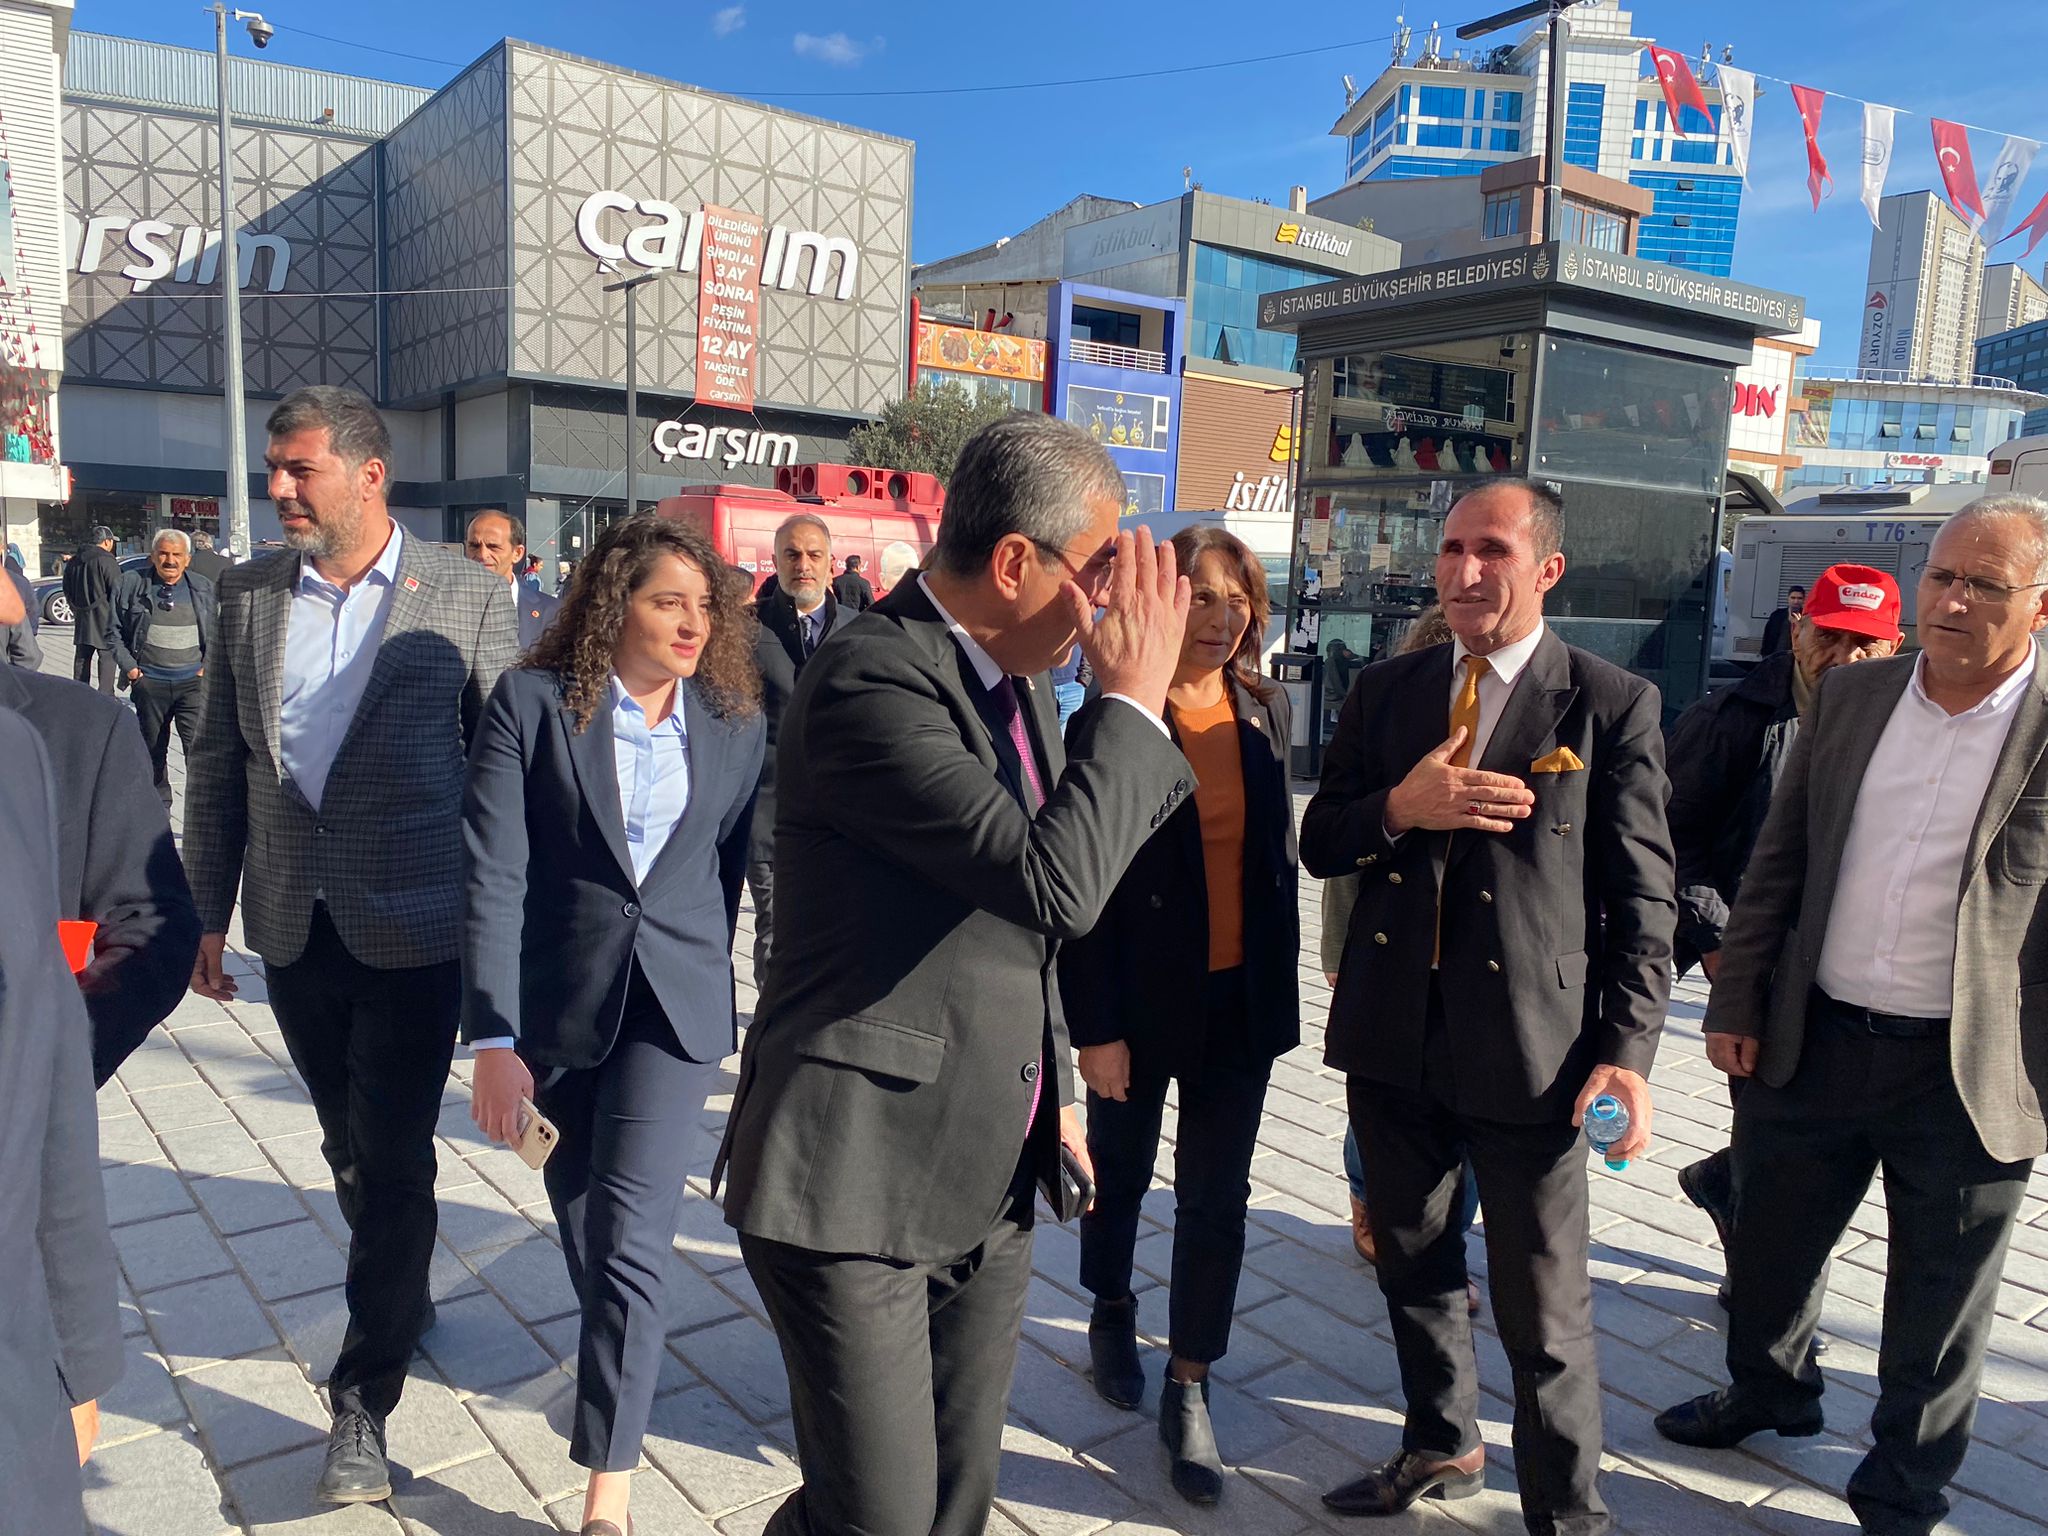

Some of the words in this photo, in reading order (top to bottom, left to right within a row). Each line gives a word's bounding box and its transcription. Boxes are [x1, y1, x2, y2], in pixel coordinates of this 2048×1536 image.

[707, 214, 759, 236] DİLEDİĞİN
[576, 190, 859, 300] çarım
[714, 229, 752, 248] ÜRÜNÜ
[1297, 226, 1353, 257] istikbal
[706, 244, 740, 263] ŞİMDİ
[741, 253, 756, 266] AL
[715, 263, 725, 277] 3
[726, 266, 747, 282] AY
[1279, 290, 1339, 315] İSTANBUL
[1342, 270, 1433, 305] BÜYÜKŞEHİR
[1436, 252, 1528, 289] BELEDİYESİ
[704, 280, 754, 303] SONRA
[1582, 253, 1643, 288] İSTANBUL
[1646, 270, 1721, 305] BÜYÜKŞEHİR
[1723, 289, 1787, 319] BELEDİYESİ
[711, 303, 746, 320] PEŞİN
[703, 315, 752, 335] FİYATINA
[701, 335, 722, 355] 12
[724, 340, 752, 360] AY
[703, 361, 748, 377] TAKSİTLE
[715, 374, 736, 387] ÖDE
[1224, 471, 1297, 512] istik
[1866, 522, 1878, 541] T
[1884, 522, 1906, 542] 76
[1842, 586, 1882, 600] Ender
